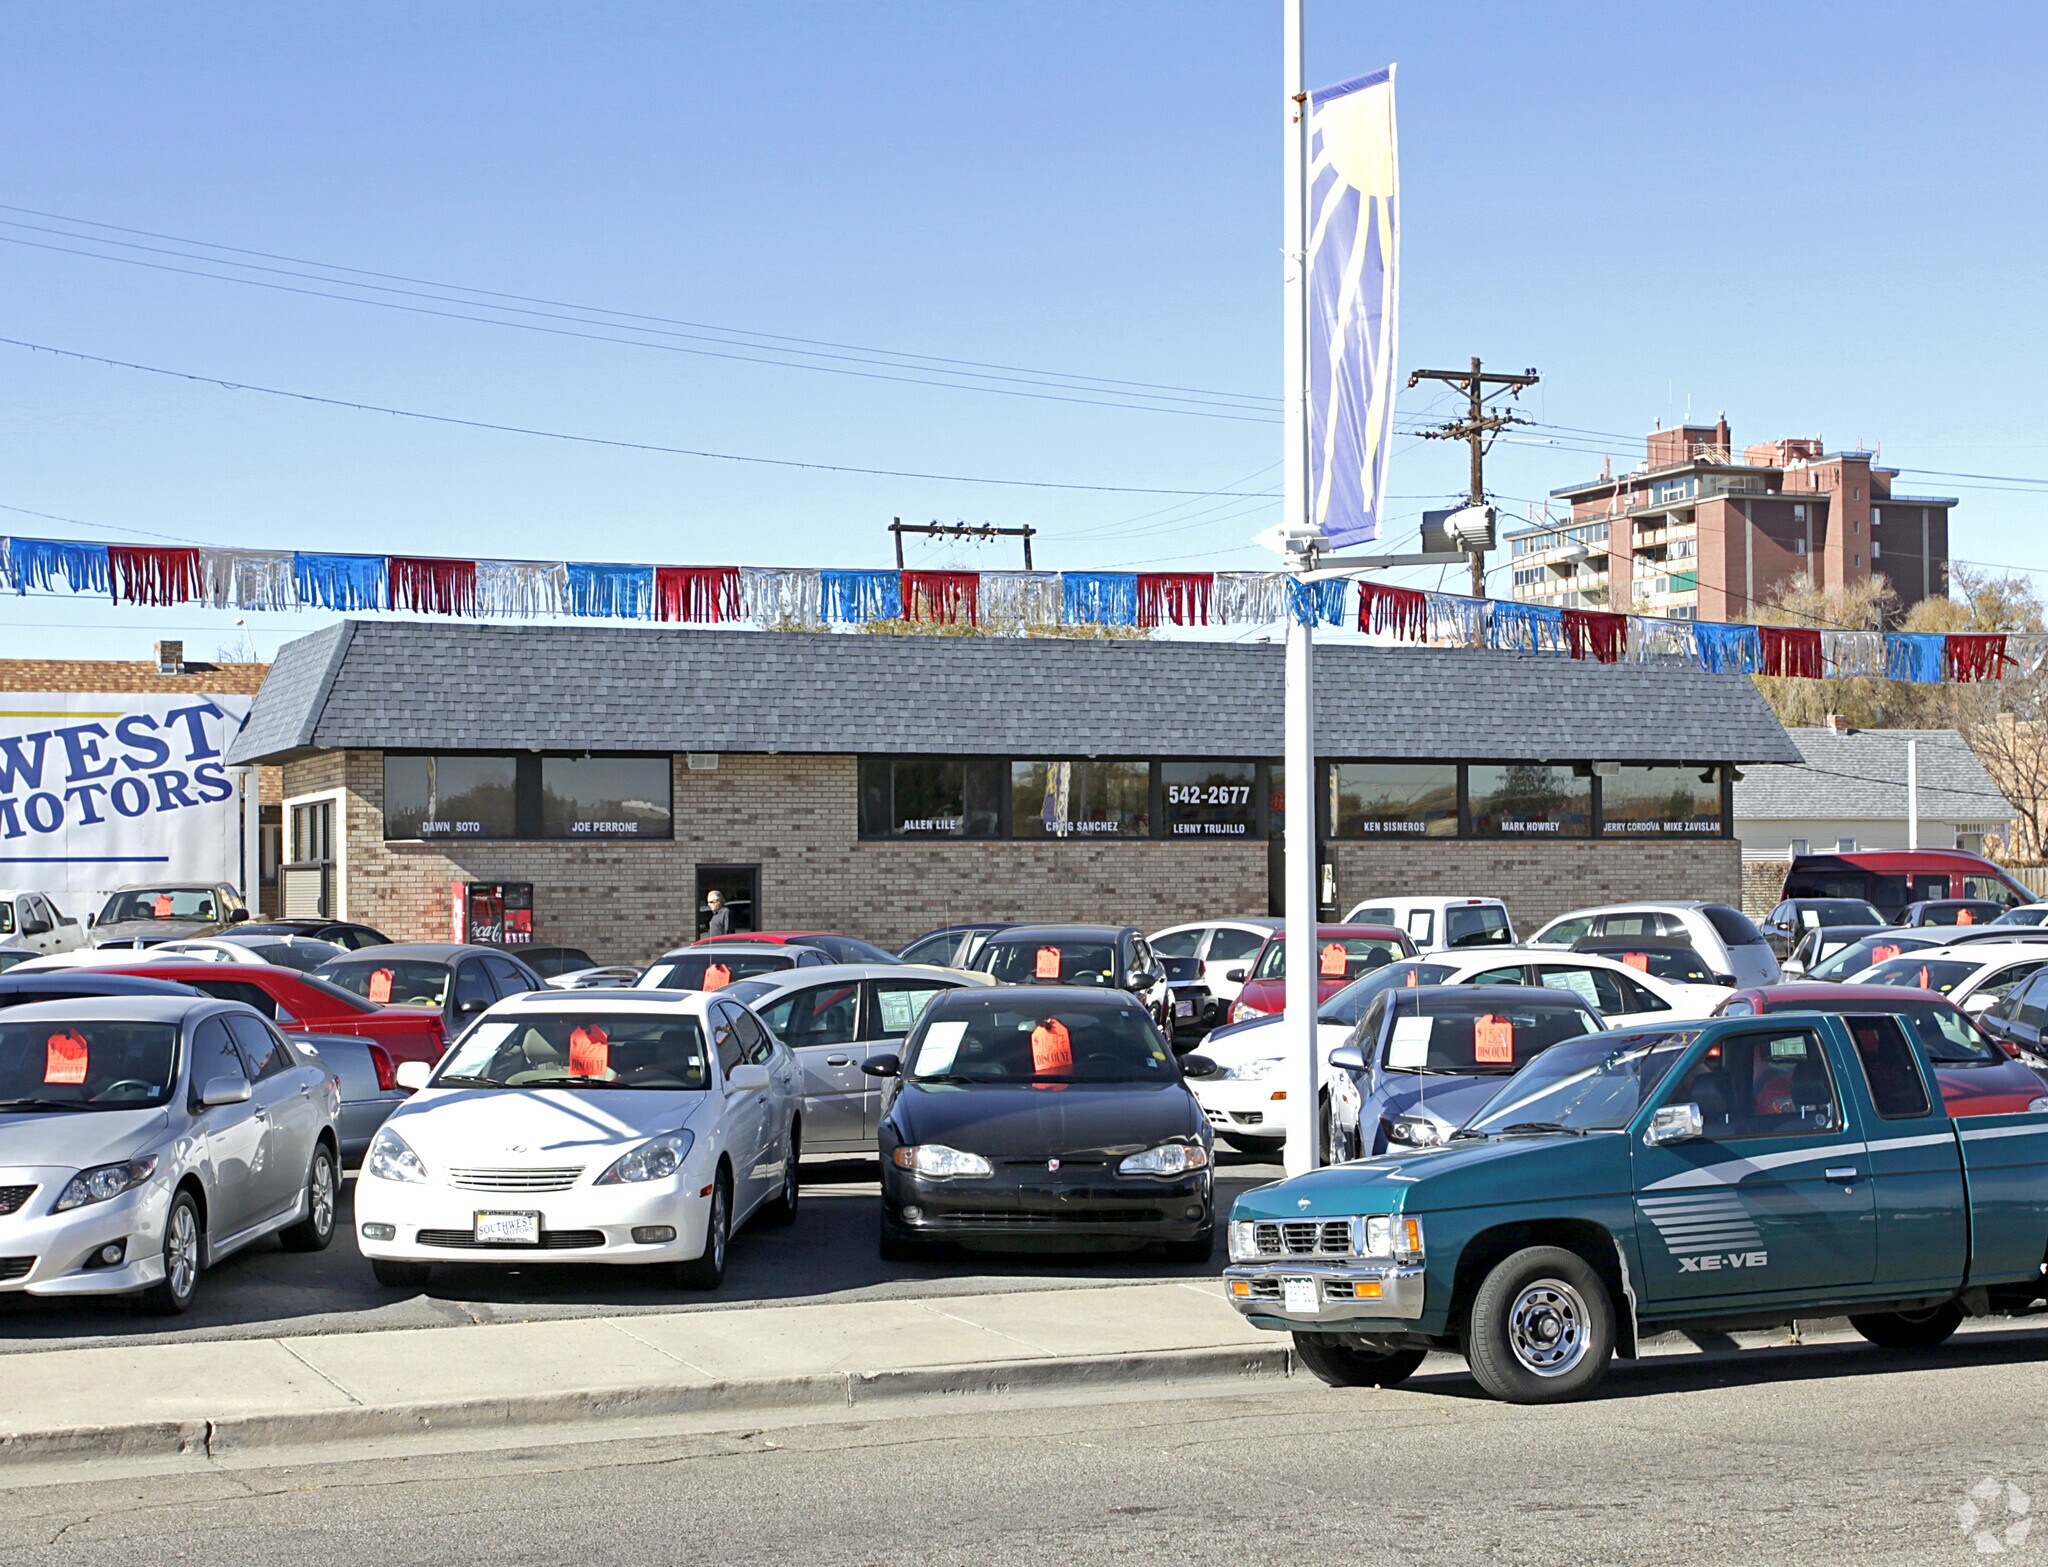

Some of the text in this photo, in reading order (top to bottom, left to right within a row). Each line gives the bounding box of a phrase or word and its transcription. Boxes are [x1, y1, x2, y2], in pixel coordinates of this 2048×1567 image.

[1169, 786, 1250, 804] 542-2677
[422, 821, 480, 832] DAWN SOTO
[572, 821, 638, 832] JOE PERRONE
[904, 819, 956, 830] ALLEN LILE
[1077, 821, 1119, 832] SANCHEZ
[1173, 823, 1245, 834] LENNY TRUJILLO
[1364, 821, 1425, 832] KEN SISNEROS
[1501, 821, 1560, 832] MARK HOWREY
[1603, 821, 1720, 832] JERRY CORDOVA MIKE ZAVISLAN
[1477, 1046, 1509, 1057] DISCOUNT
[1036, 1051, 1069, 1065] DISCOUNT
[571, 1058, 605, 1071] DISCOUNT
[49, 1065, 84, 1077] DISCOUNT
[478, 1216, 533, 1236] SOUTHWEST
[503, 1226, 535, 1236] MOTORS
[1678, 1251, 1768, 1273] XE-V6
